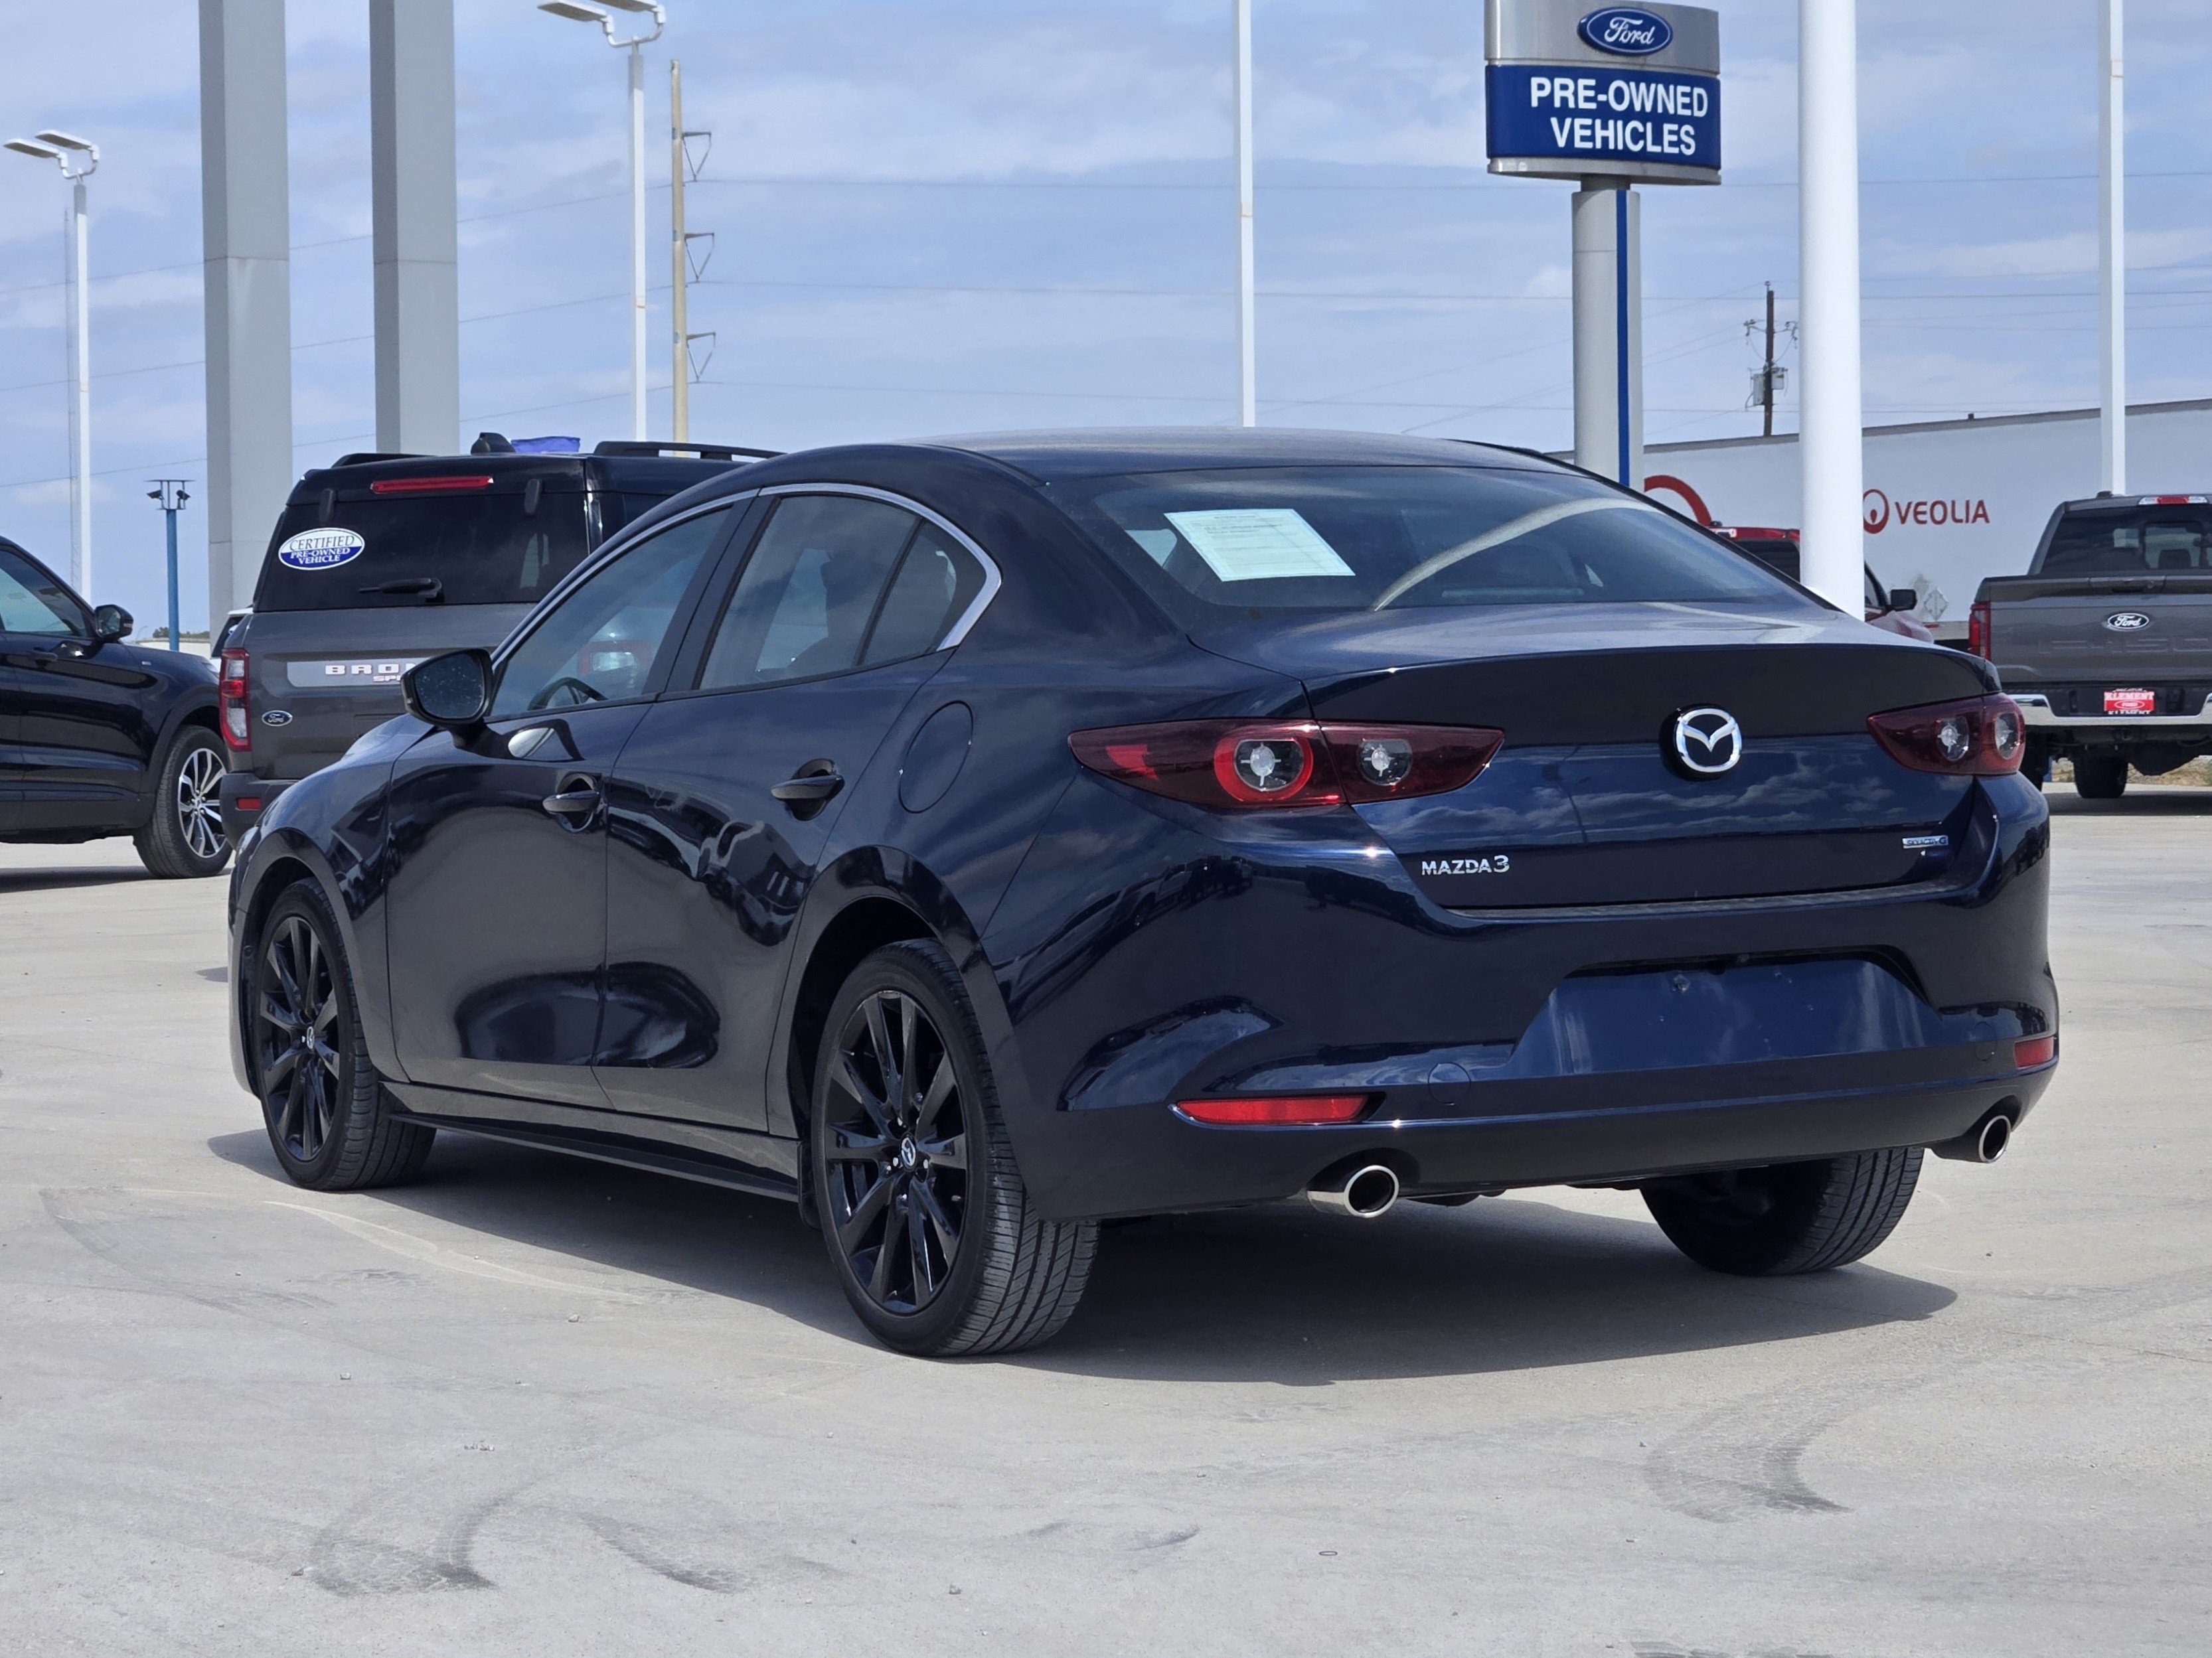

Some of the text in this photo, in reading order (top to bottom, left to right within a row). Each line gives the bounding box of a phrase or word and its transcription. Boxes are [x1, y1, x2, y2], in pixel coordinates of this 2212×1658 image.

[1604, 16, 1656, 45] Ford
[1530, 76, 1709, 117] PRE-OWNED
[1549, 117, 1696, 156] VEHICLES
[1894, 499, 1990, 525] VEOLIA
[289, 536, 355, 551] CERTIFIED
[290, 547, 351, 559] PRE-OWNED
[298, 555, 341, 564] VEHICLE
[2114, 615, 2142, 627] Ford
